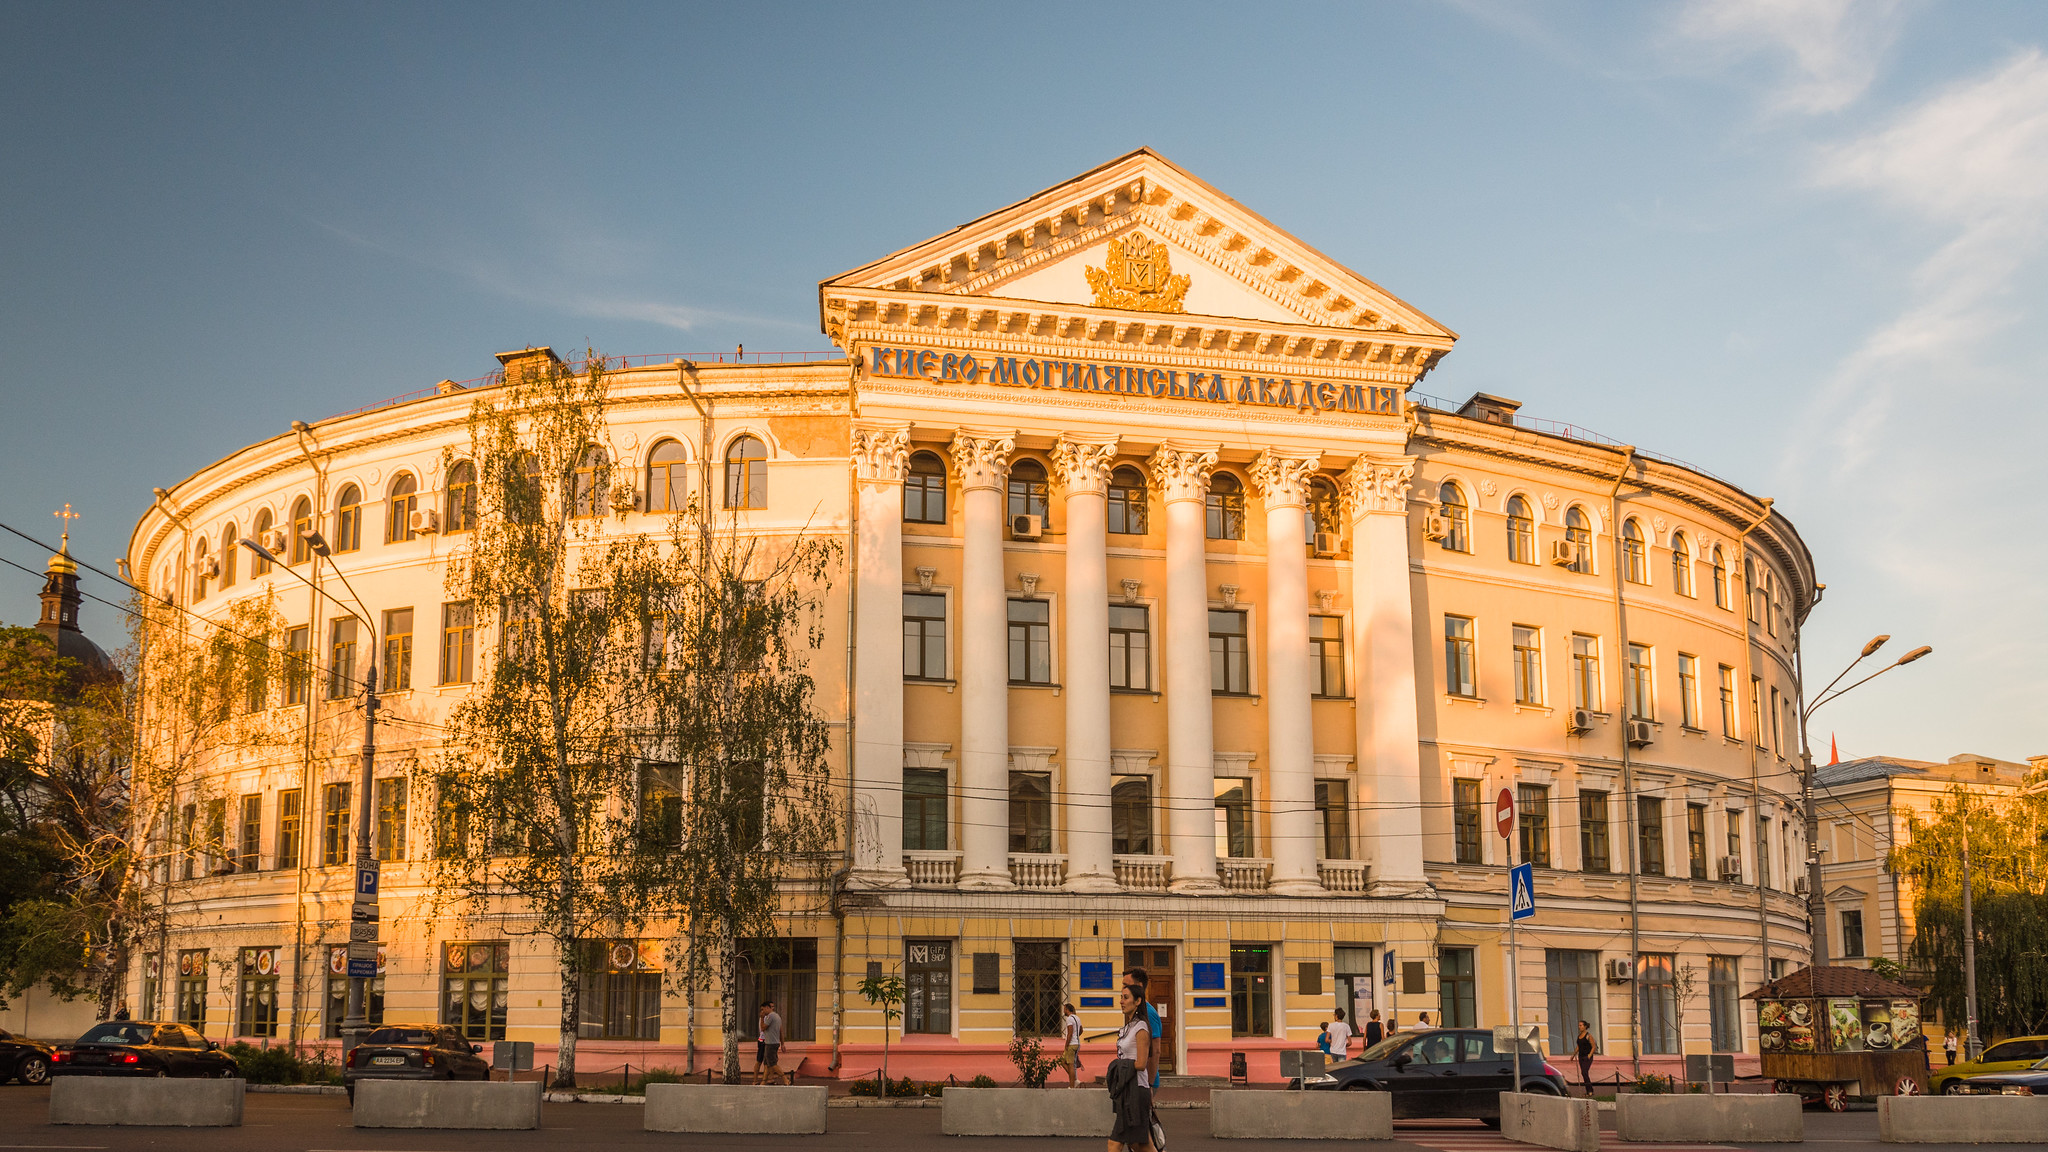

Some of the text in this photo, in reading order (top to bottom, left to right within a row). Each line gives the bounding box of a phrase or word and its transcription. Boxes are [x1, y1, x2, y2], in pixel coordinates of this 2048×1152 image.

[871, 346, 1400, 416] КИЄВО-МОГИЛЯНСЬКА АКАДЕМІЯ
[358, 861, 380, 870] ЗОНА
[362, 871, 374, 892] P
[930, 946, 947, 955] GIFT
[931, 953, 946, 962] SHOP
[350, 968, 376, 976] ПАРКОМАТ
